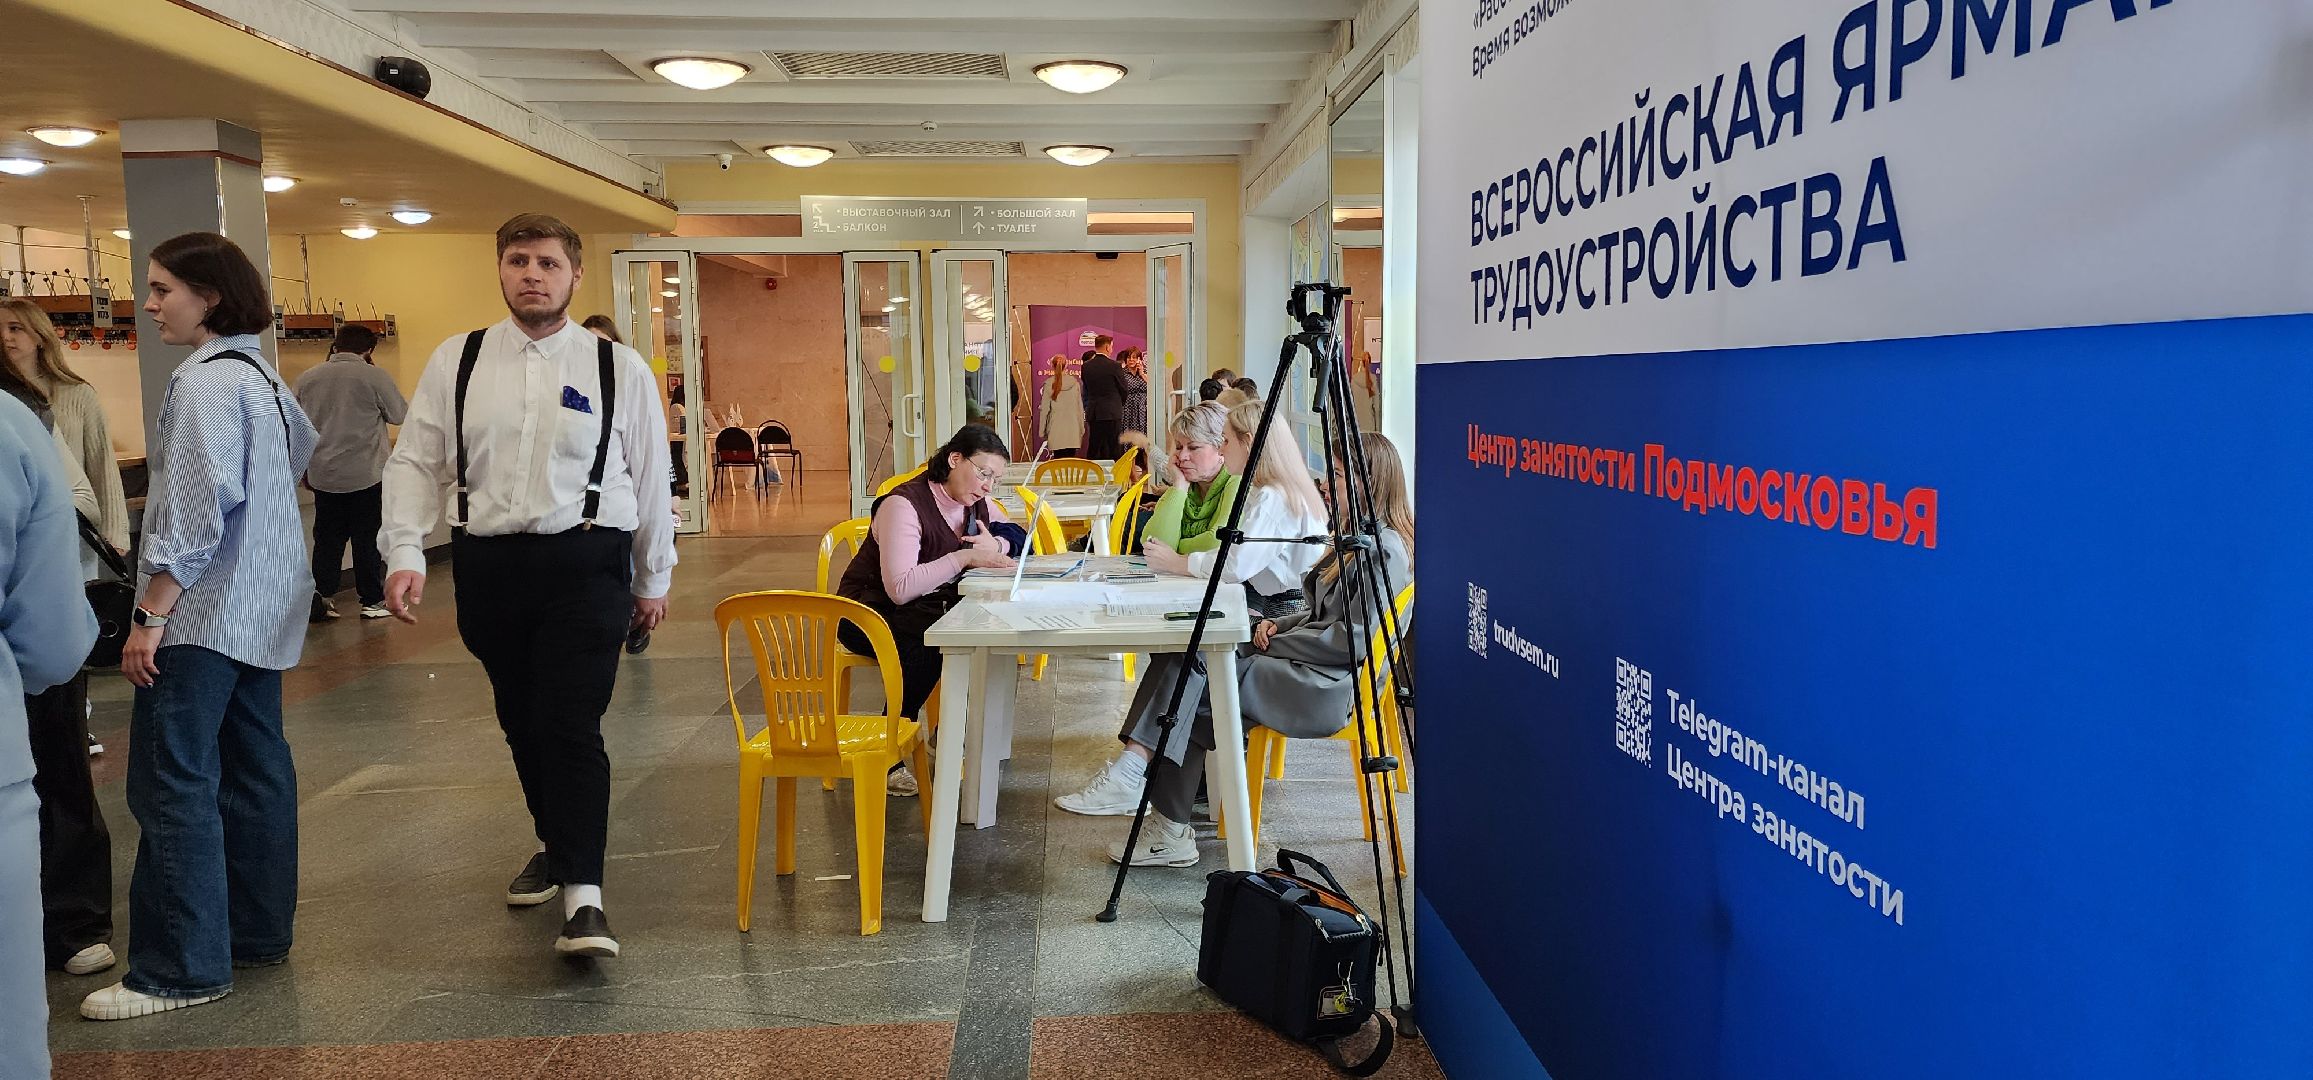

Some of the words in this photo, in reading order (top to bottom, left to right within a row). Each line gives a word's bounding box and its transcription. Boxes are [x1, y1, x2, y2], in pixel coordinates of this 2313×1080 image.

[1472, 26, 1510, 80] Время
[1471, 34, 1806, 247] ВСЕРОССИЙСКАЯ
[842, 206, 926, 218] ВЫСТАВОЧНЫЙ
[929, 208, 952, 218] ЗАЛ
[843, 222, 888, 232] БАЛКОН
[997, 207, 1052, 218] БОЛЬШОЙ
[1054, 209, 1077, 218] ЗАЛ
[997, 223, 1038, 233] ТУАЛЕТ
[1471, 156, 1908, 332] ТРУДОУСТРОЙСТВА
[1468, 424, 1517, 477] Центр
[1520, 438, 1635, 492] занятости
[1644, 443, 1938, 549] Подмосковья
[1494, 618, 1560, 679] trudvsem.ru
[1667, 688, 1865, 830] Telegram-канал
[1667, 743, 1746, 824] Центра
[1752, 802, 1905, 926] занятости
